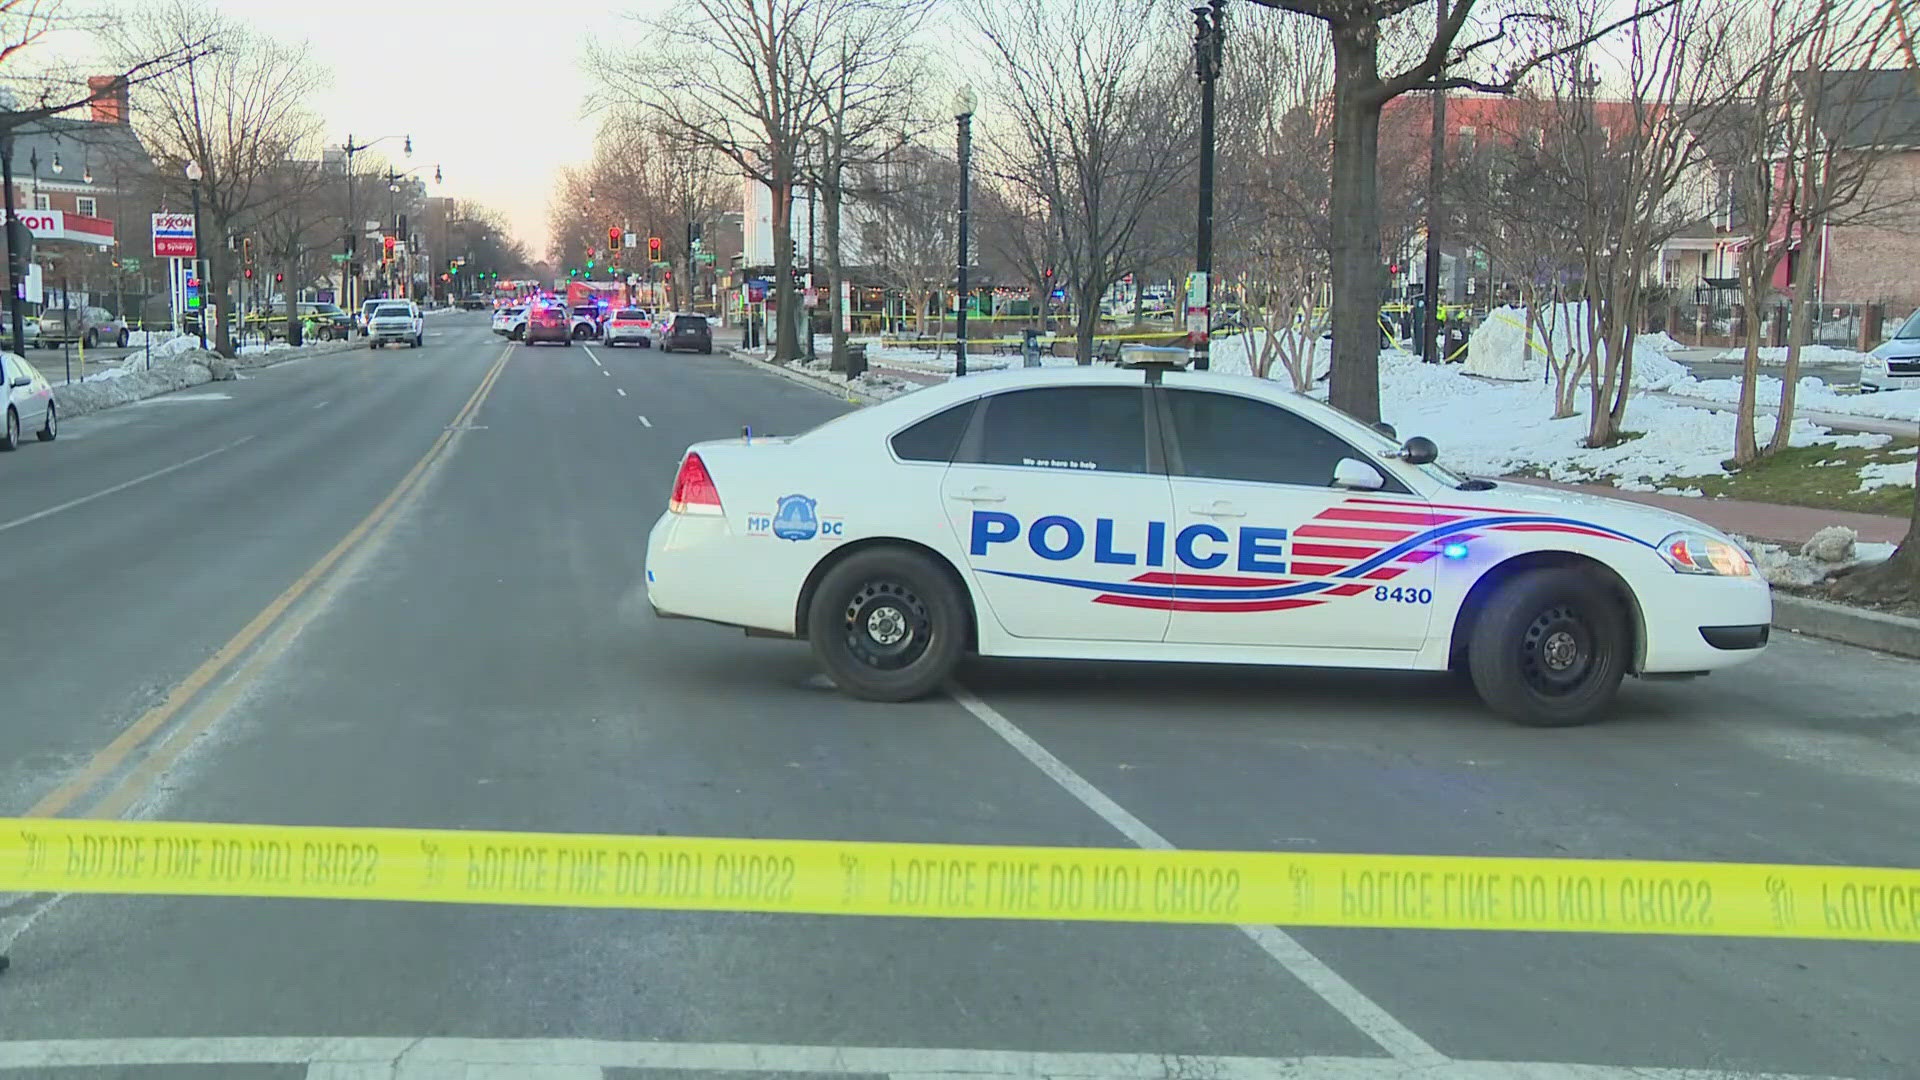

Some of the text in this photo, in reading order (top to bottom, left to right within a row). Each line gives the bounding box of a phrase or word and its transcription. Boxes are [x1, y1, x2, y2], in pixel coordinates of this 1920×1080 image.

[157, 216, 192, 230] EXXON
[1037, 459, 1049, 467] are
[1051, 459, 1068, 468] here
[1080, 461, 1097, 470] help
[748, 517, 770, 531] MP
[822, 521, 843, 535] DC
[970, 510, 1288, 576] POLICE
[1375, 586, 1432, 604] 8430
